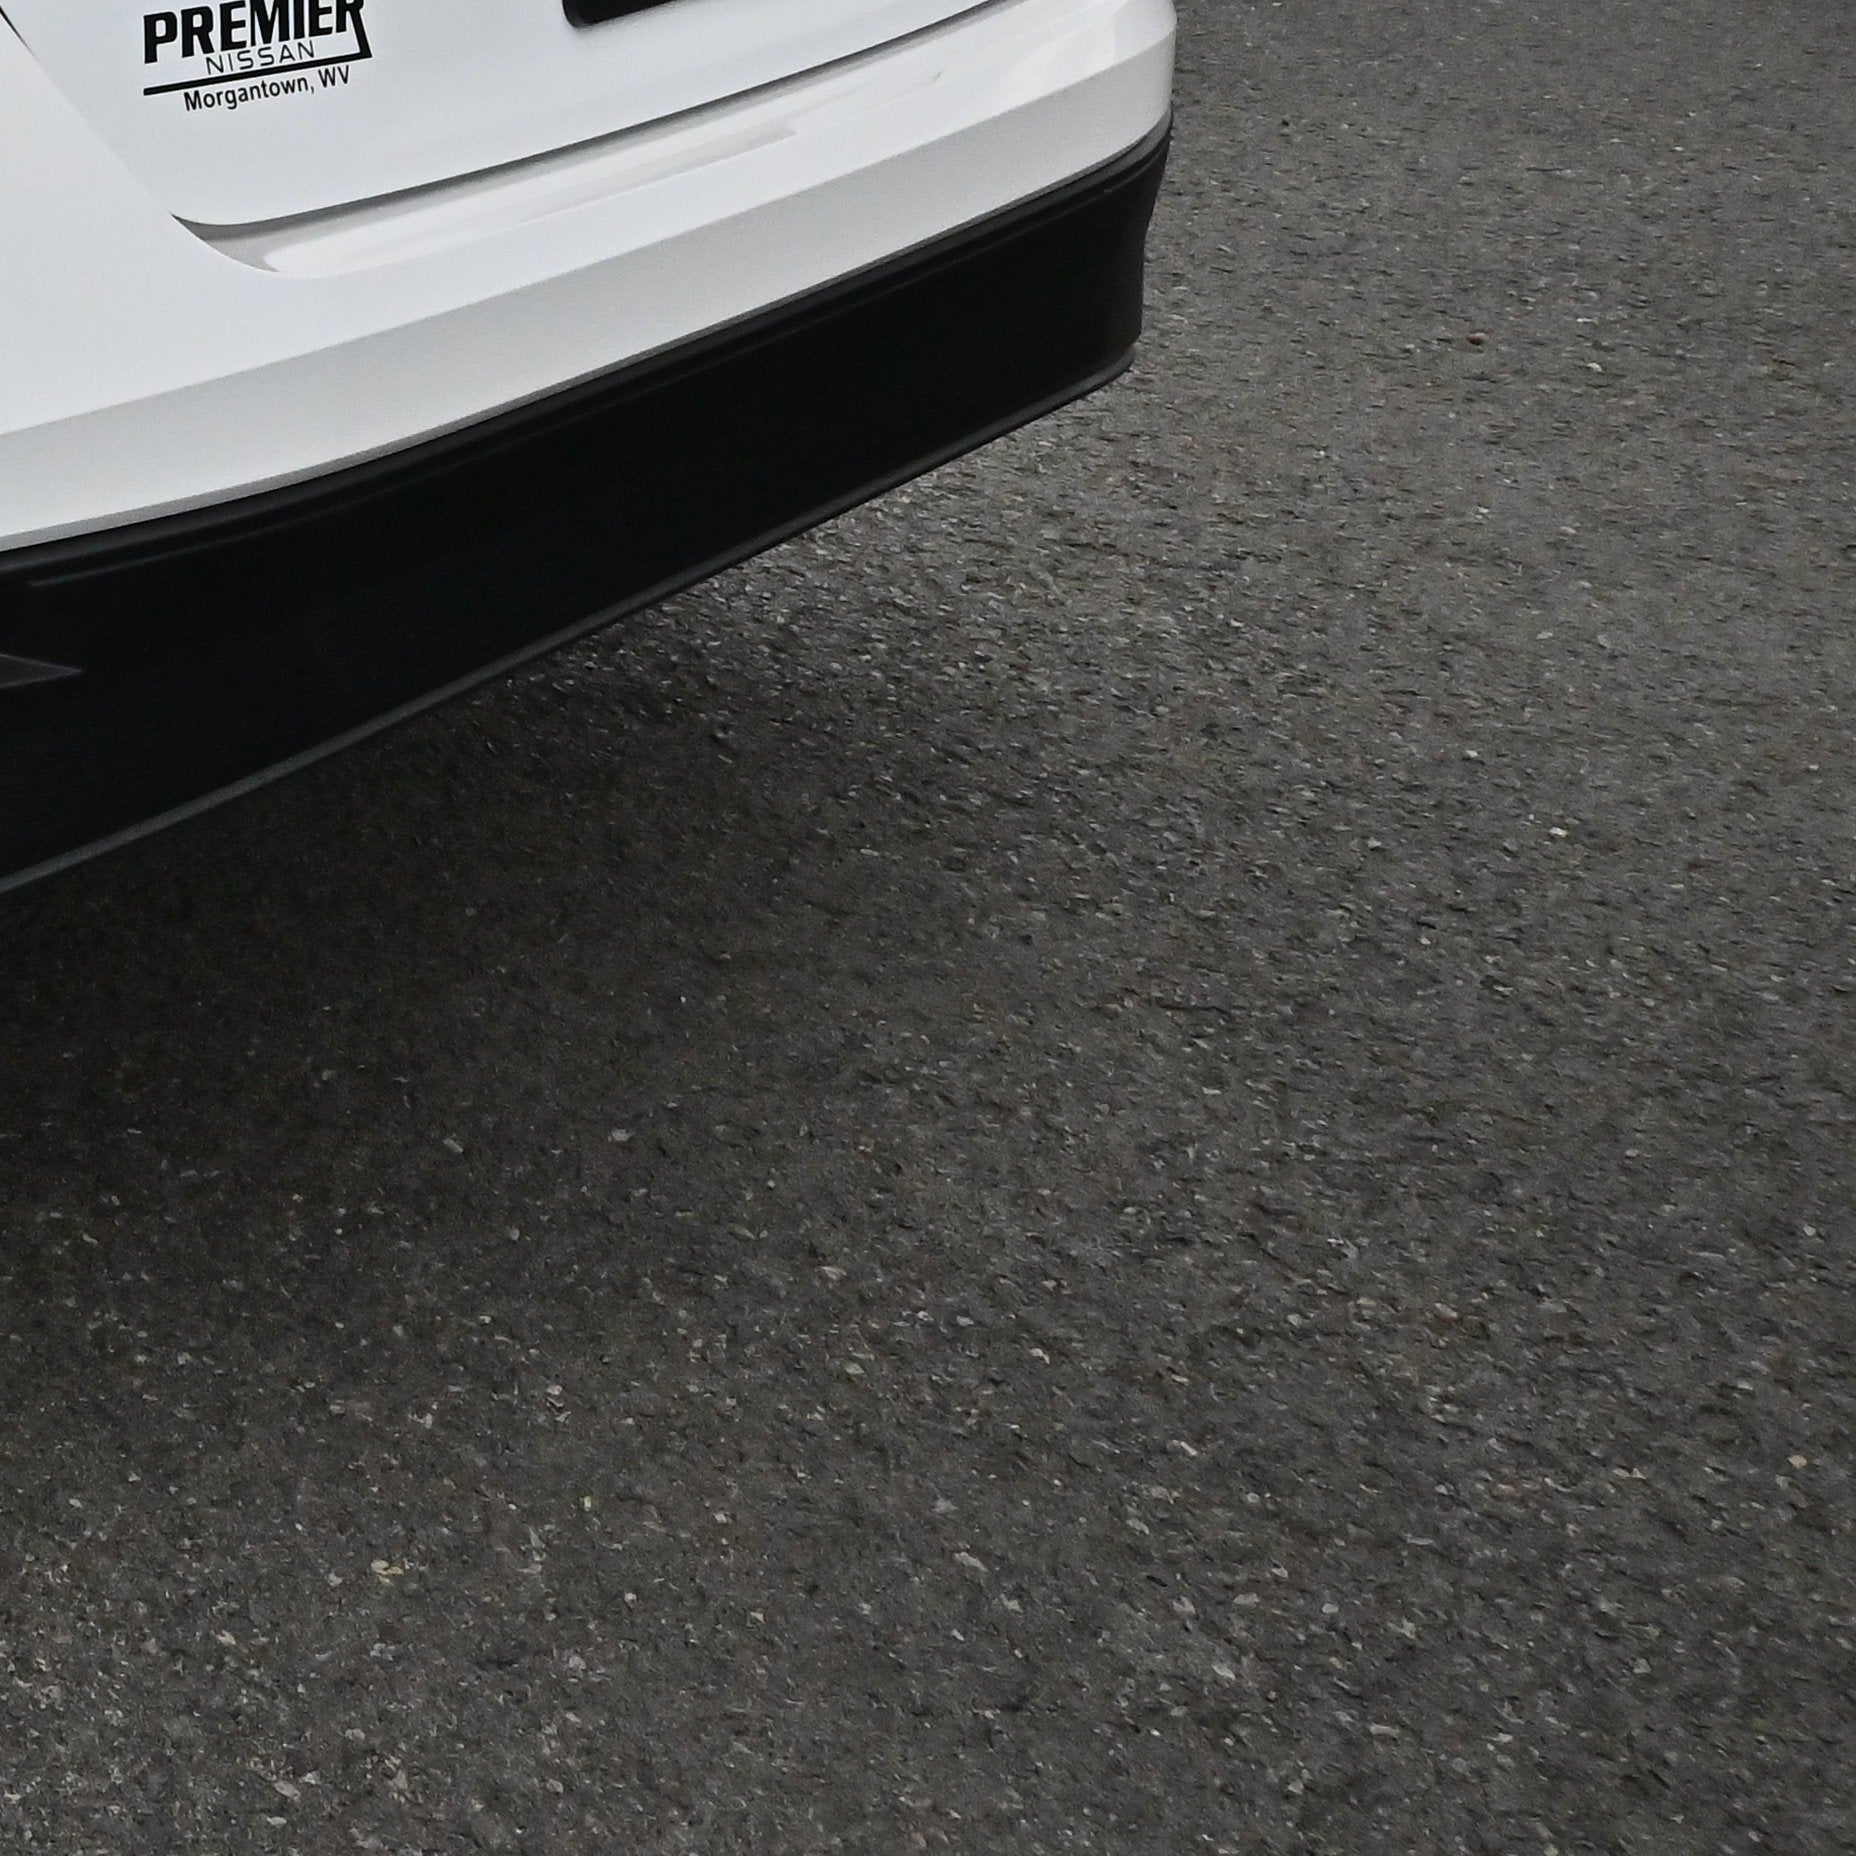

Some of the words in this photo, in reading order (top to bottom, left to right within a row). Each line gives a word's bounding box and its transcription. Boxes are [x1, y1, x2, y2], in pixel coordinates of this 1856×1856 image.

[205, 39, 316, 75] NISSAN
[183, 76, 316, 112] Morgantown,
[317, 64, 351, 89] WV
